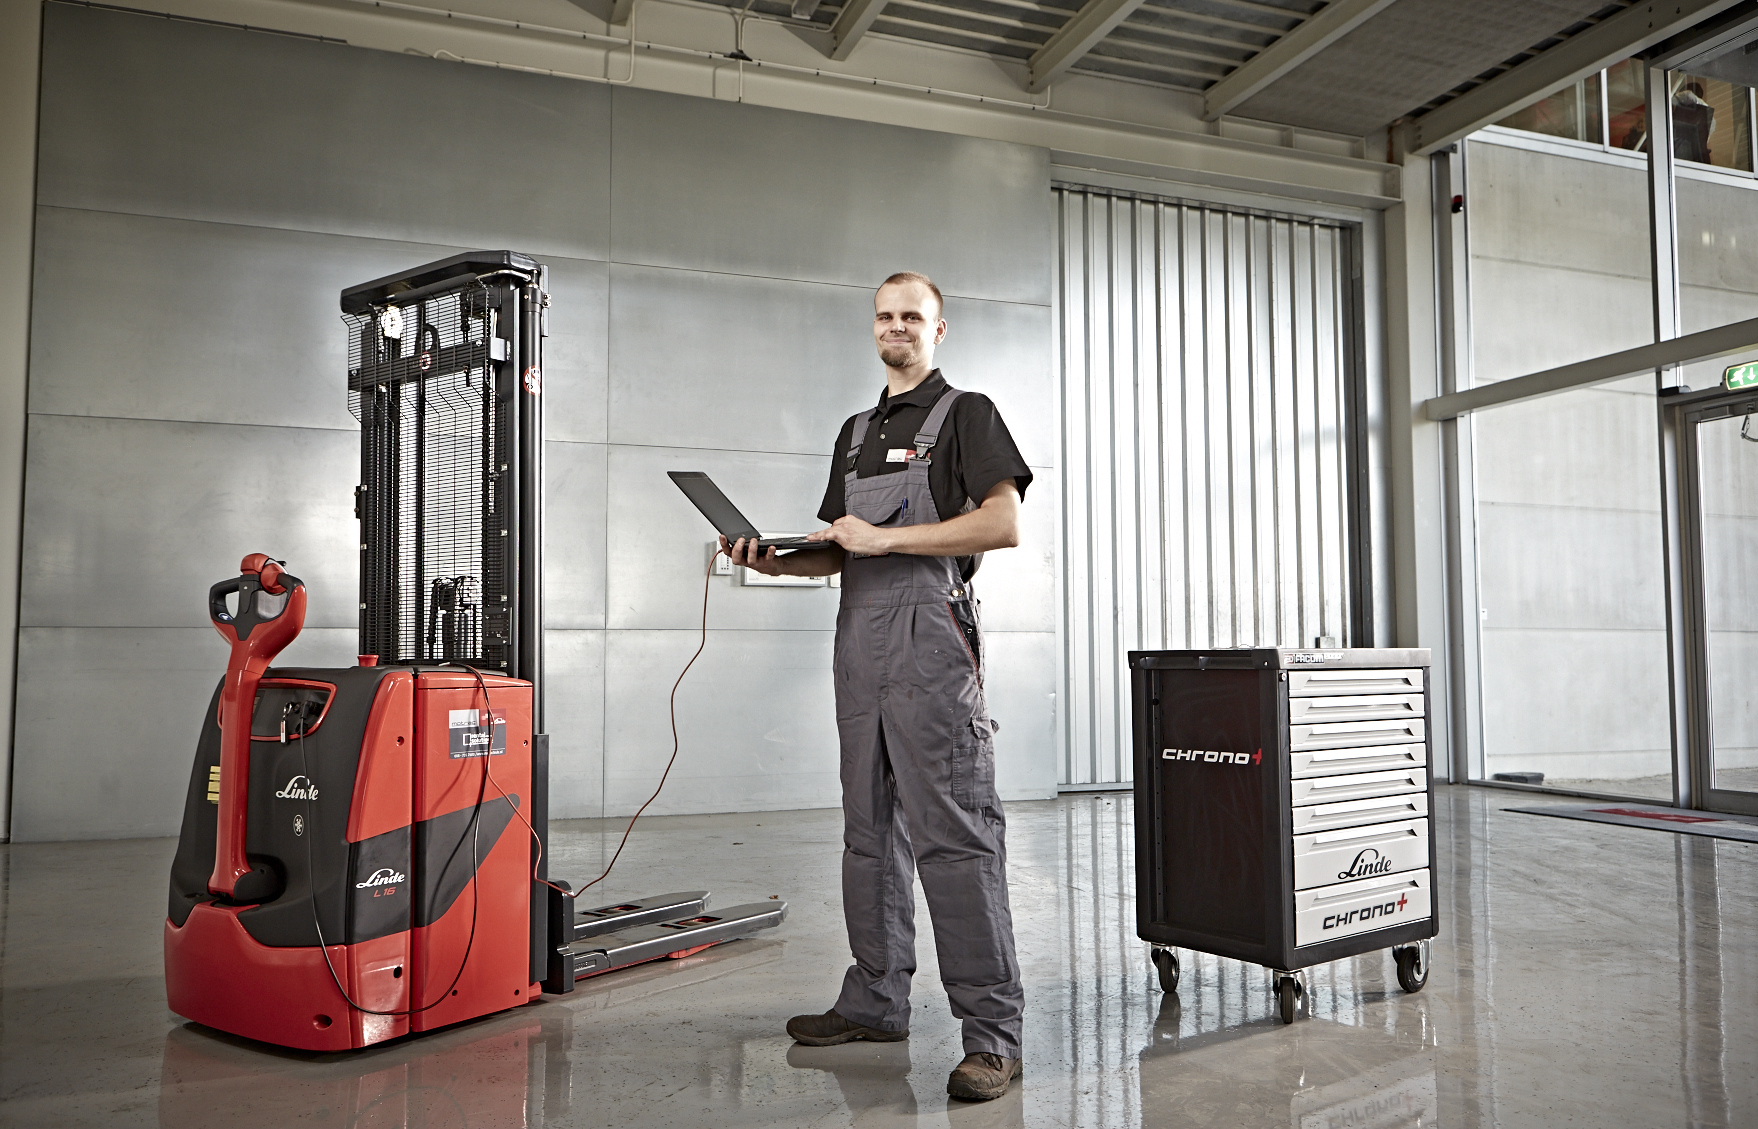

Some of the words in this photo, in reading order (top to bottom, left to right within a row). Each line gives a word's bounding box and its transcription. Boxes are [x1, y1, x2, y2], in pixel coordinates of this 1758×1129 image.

[275, 775, 319, 801] Linde
[1338, 848, 1392, 880] Linde
[355, 868, 405, 889] Linde
[373, 889, 381, 898] L
[383, 886, 397, 896] 16
